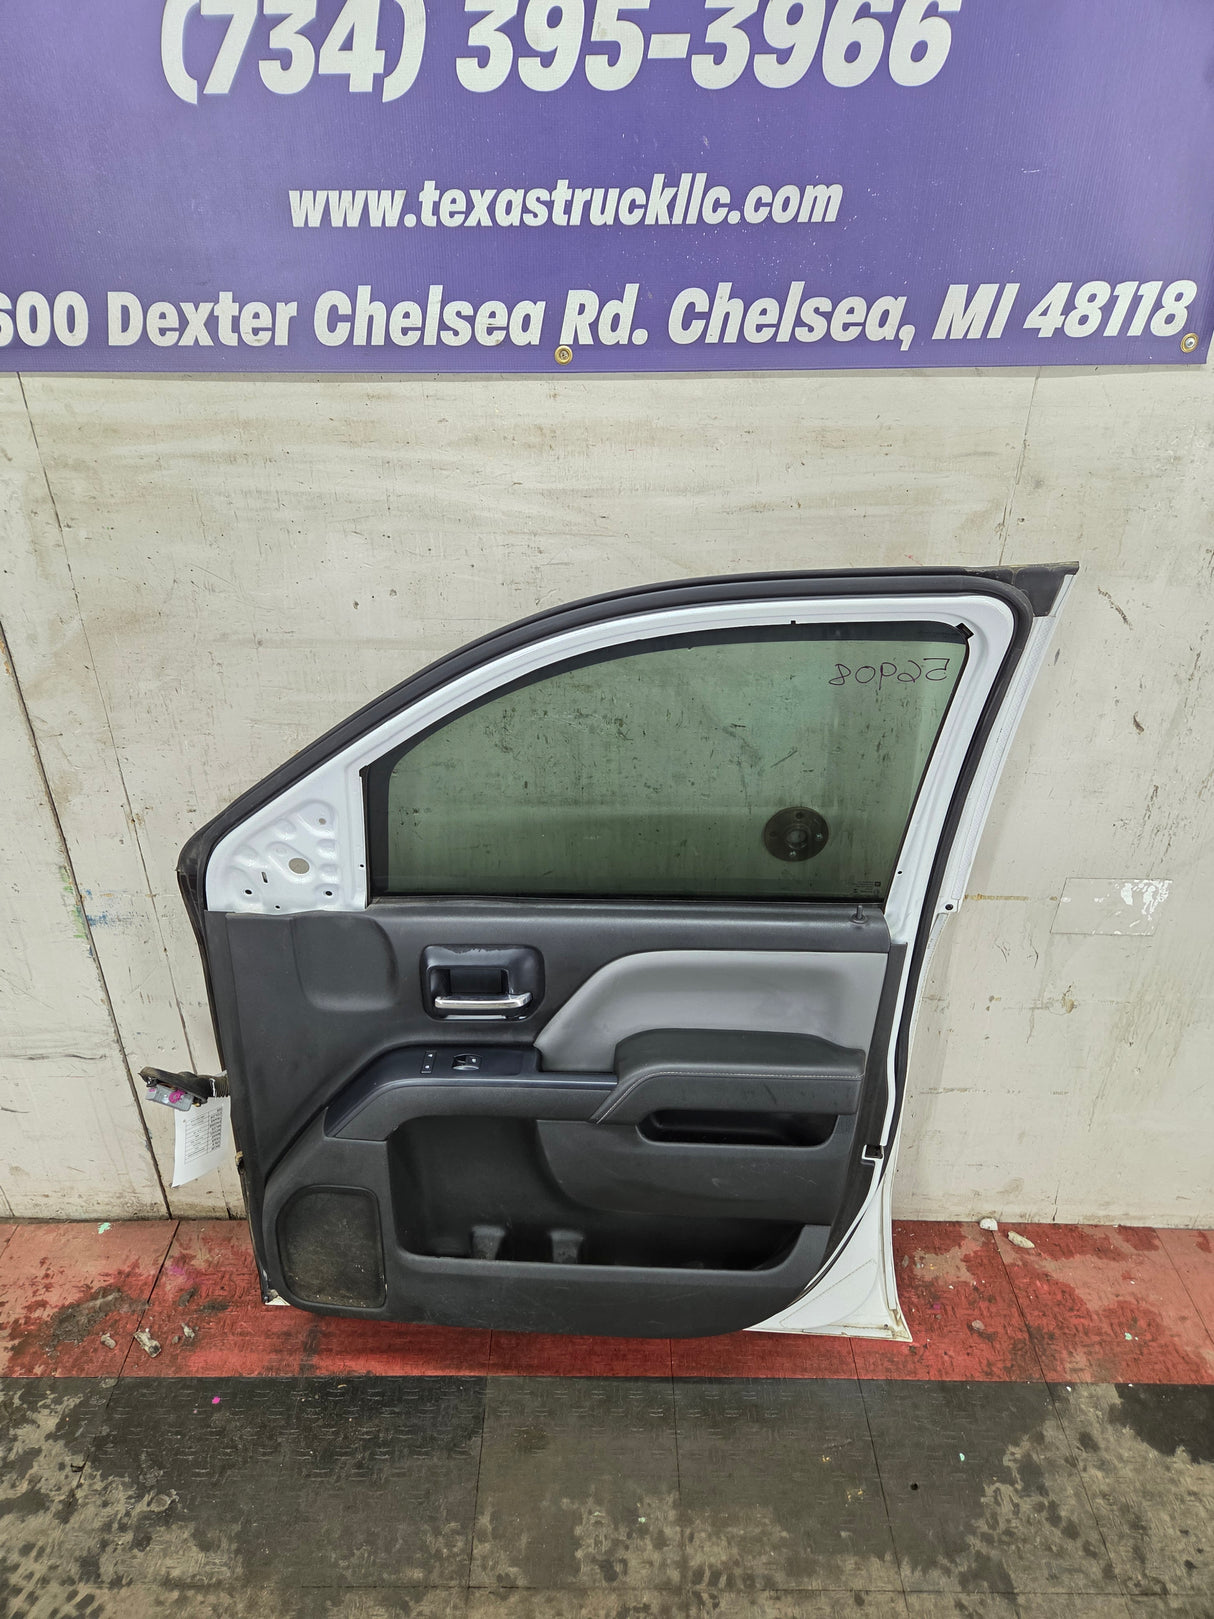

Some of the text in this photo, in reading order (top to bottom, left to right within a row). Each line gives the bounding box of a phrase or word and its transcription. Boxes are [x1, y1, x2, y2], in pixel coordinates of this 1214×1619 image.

[160, 0, 962, 105] (734) 395-3966
[288, 173, 844, 228] www.texastruckllc.com
[107, 291, 298, 347] Dexter
[313, 284, 546, 347] Chelsea
[559, 283, 649, 346] Rd.
[668, 281, 916, 352] Chelsea,
[931, 283, 1020, 340] MI
[1022, 279, 1198, 338] 48118
